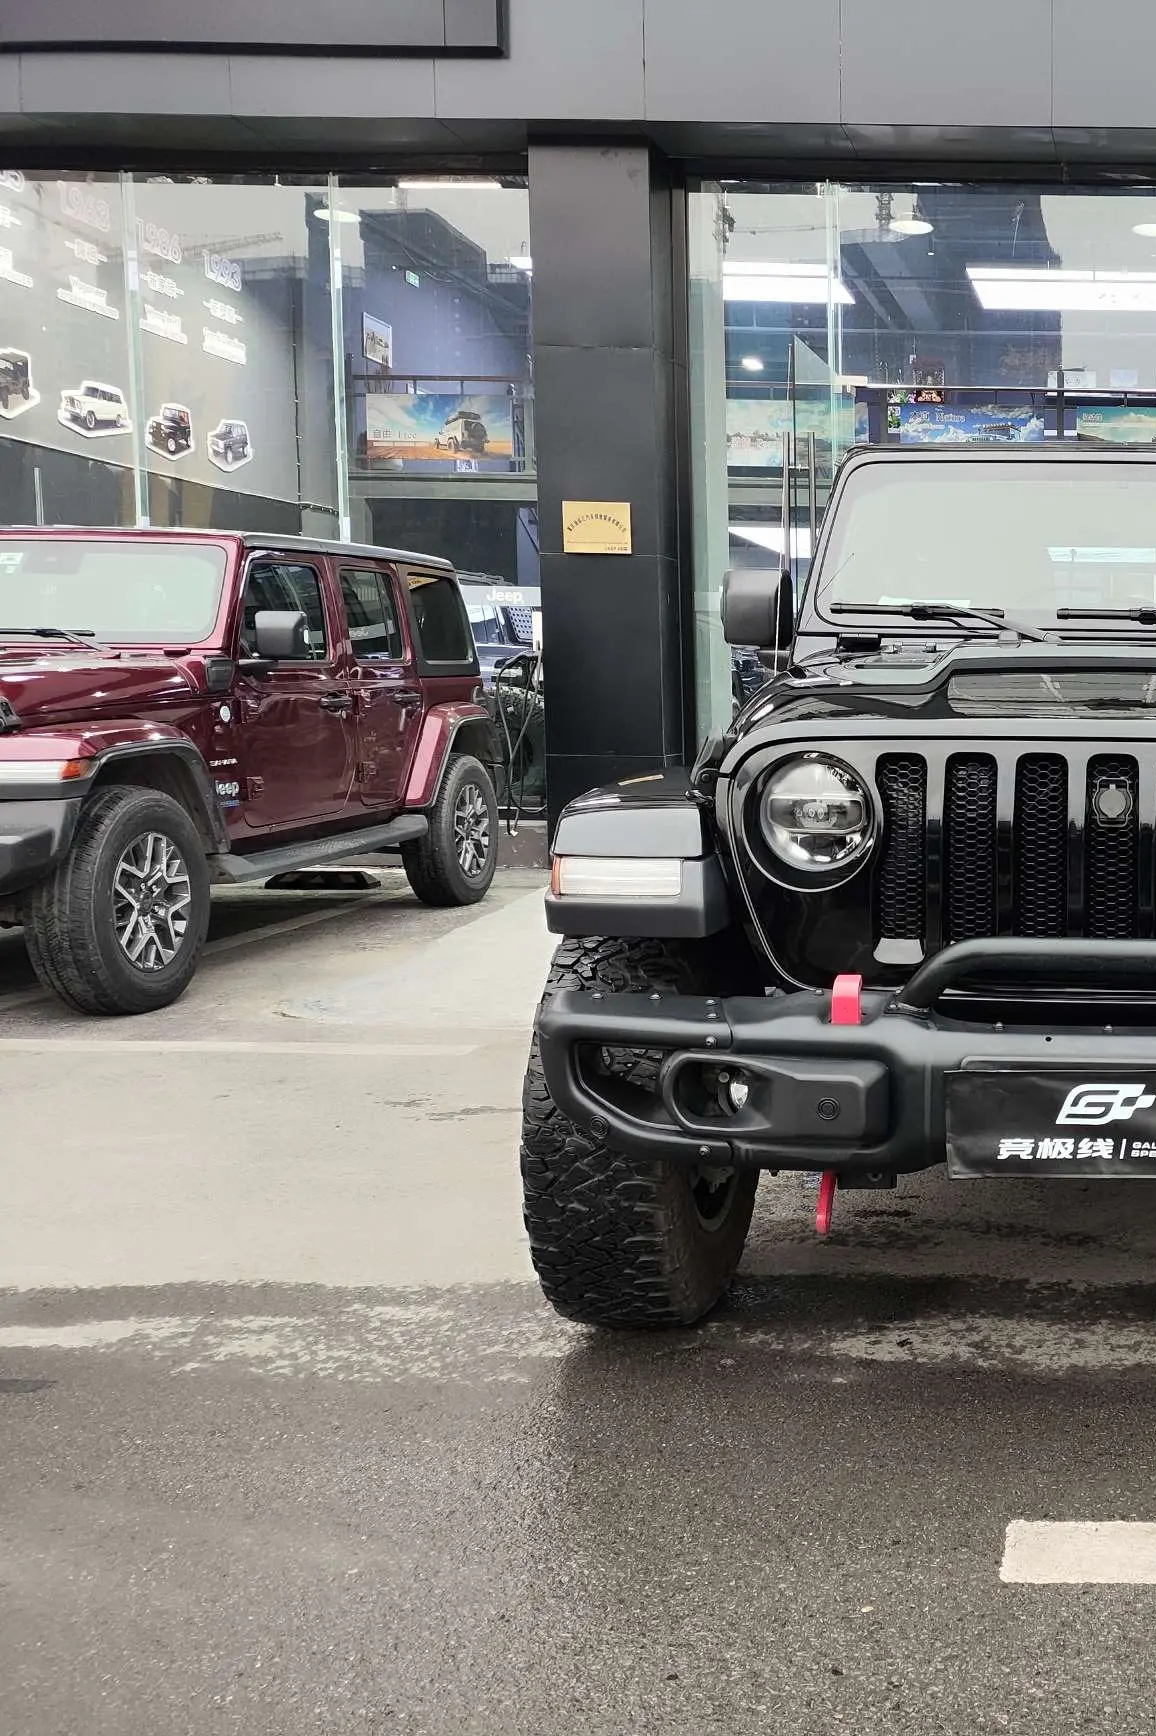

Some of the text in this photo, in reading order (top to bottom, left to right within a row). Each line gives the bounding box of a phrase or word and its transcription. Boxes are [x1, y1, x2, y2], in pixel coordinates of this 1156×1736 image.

[57, 180, 110, 232] 1963
[136, 217, 182, 264] 1986
[202, 249, 242, 292] 1993
[486, 588, 523, 605] Jeep
